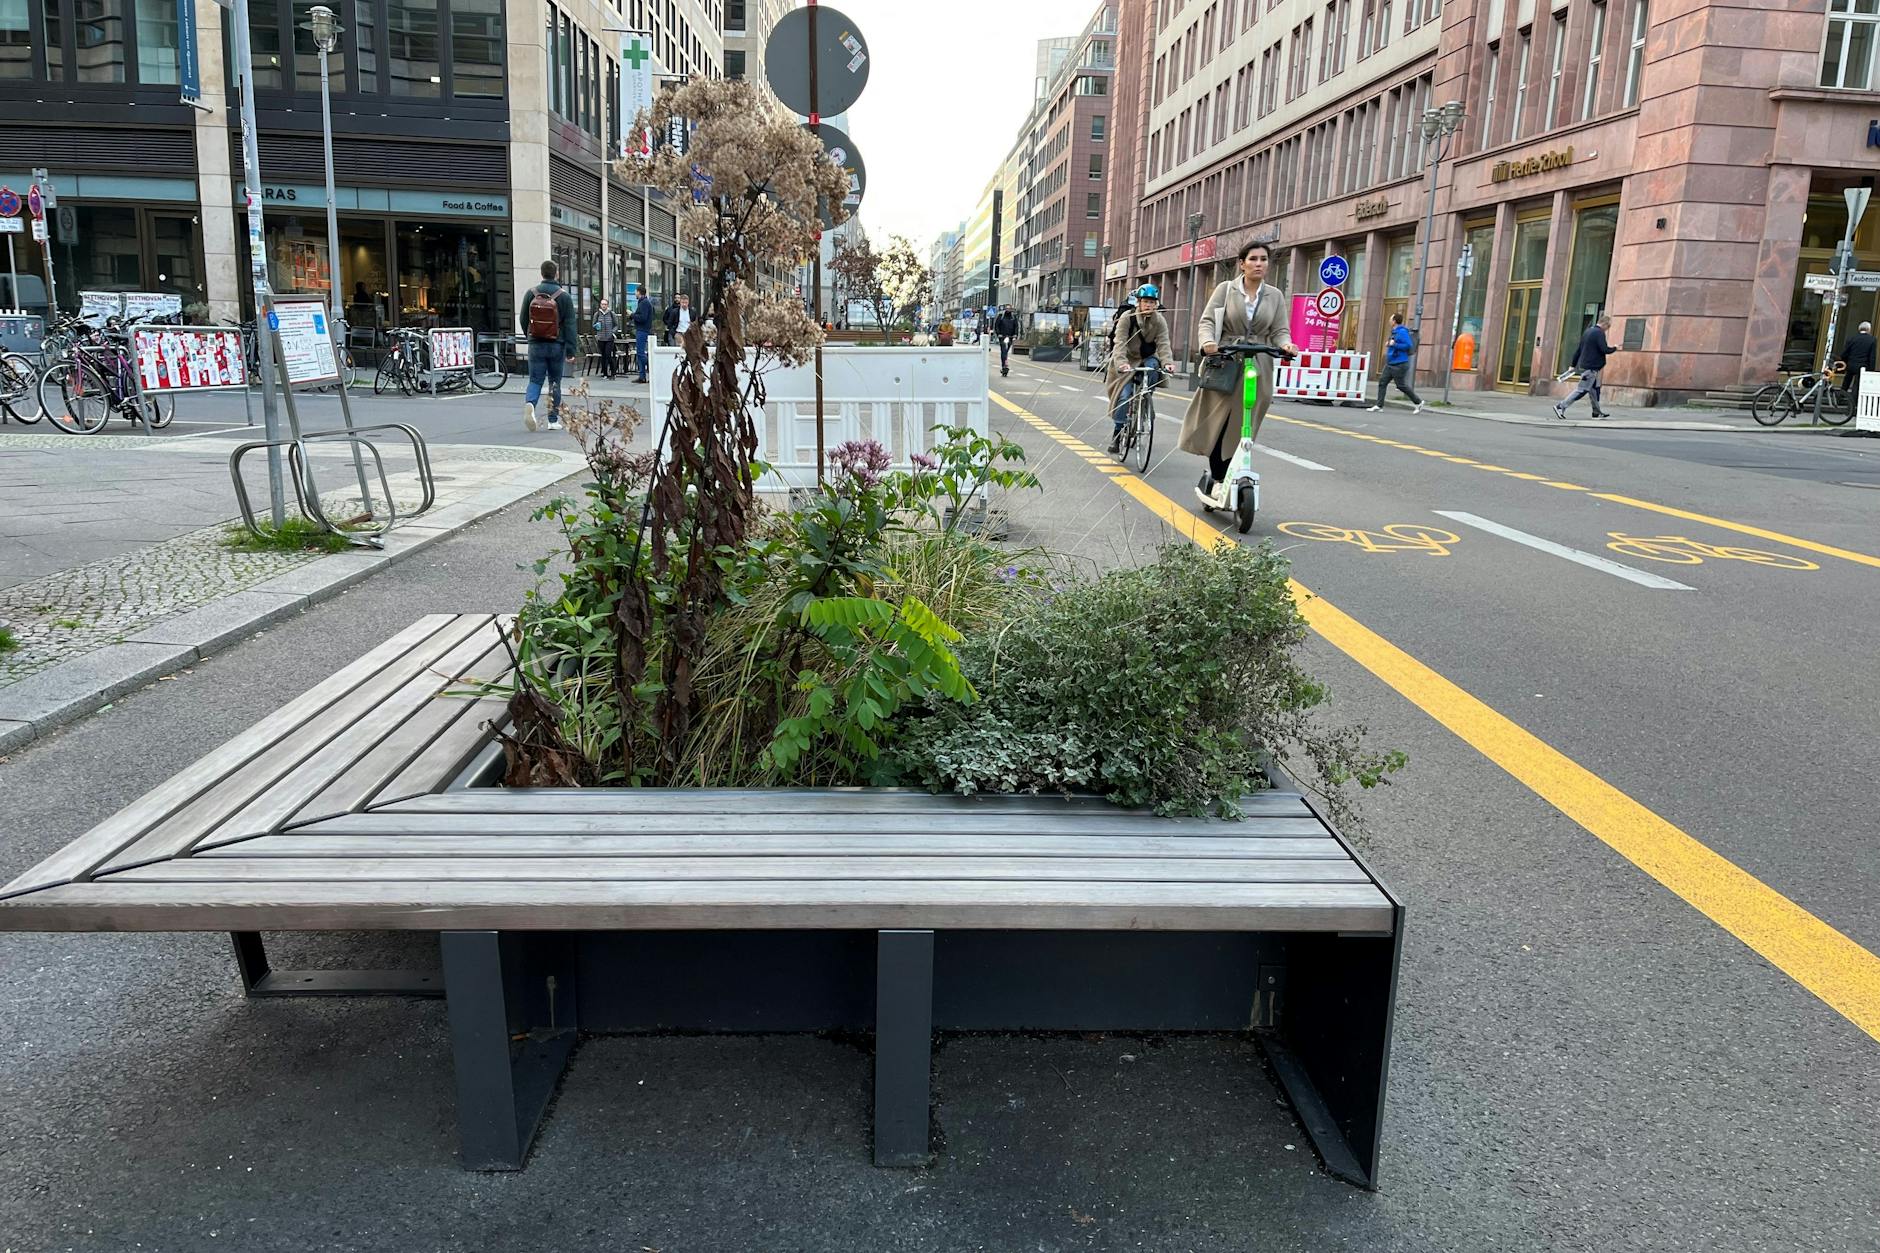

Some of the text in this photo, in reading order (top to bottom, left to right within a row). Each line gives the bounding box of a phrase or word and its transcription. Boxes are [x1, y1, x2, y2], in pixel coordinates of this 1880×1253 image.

[442, 200, 504, 211] Food & Coffee
[1322, 296, 1338, 308] 20
[1305, 318, 1314, 326] 74
